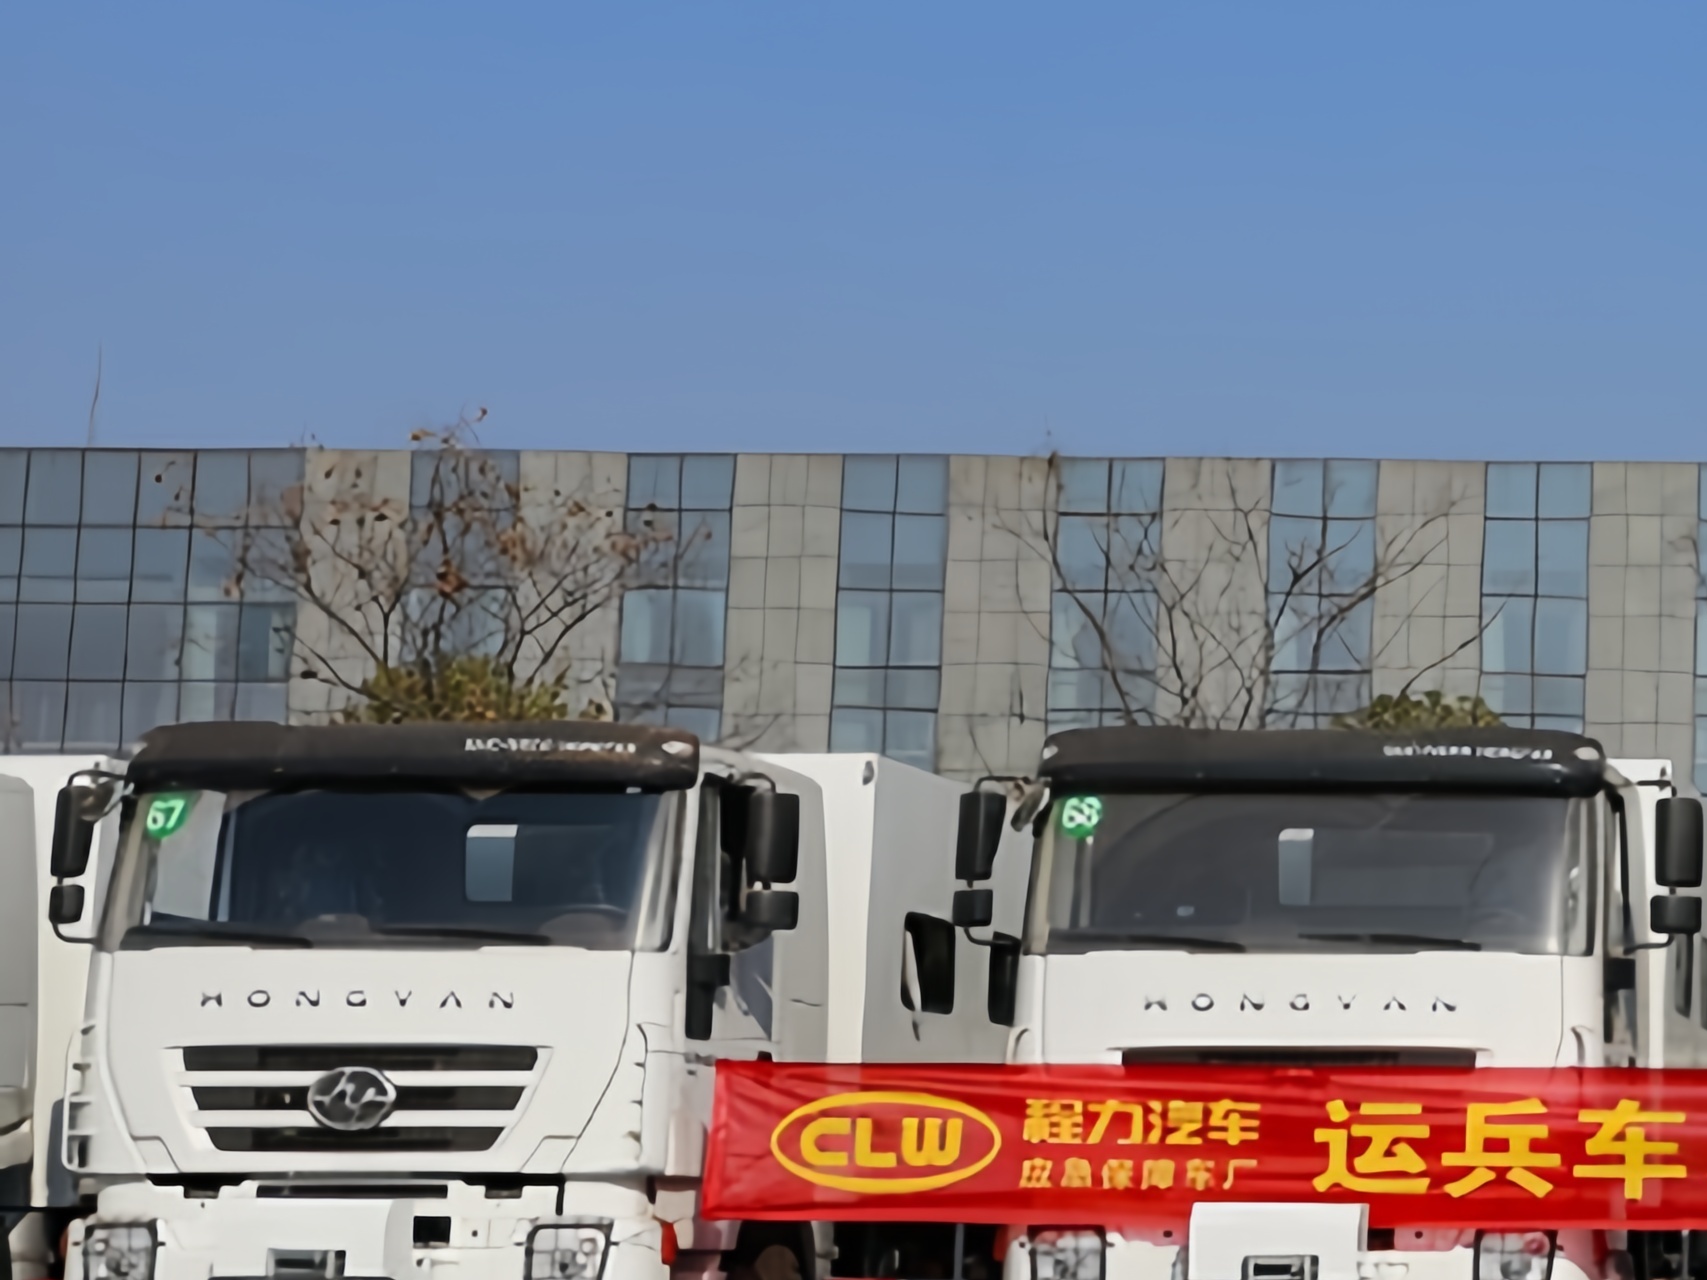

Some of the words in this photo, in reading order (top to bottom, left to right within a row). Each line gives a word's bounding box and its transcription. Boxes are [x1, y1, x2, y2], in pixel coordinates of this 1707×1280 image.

[147, 799, 185, 831] 67
[201, 990, 514, 1009] HONGYAN
[1022, 1098, 1262, 1146] 程力汽车
[800, 1117, 963, 1168] CLW
